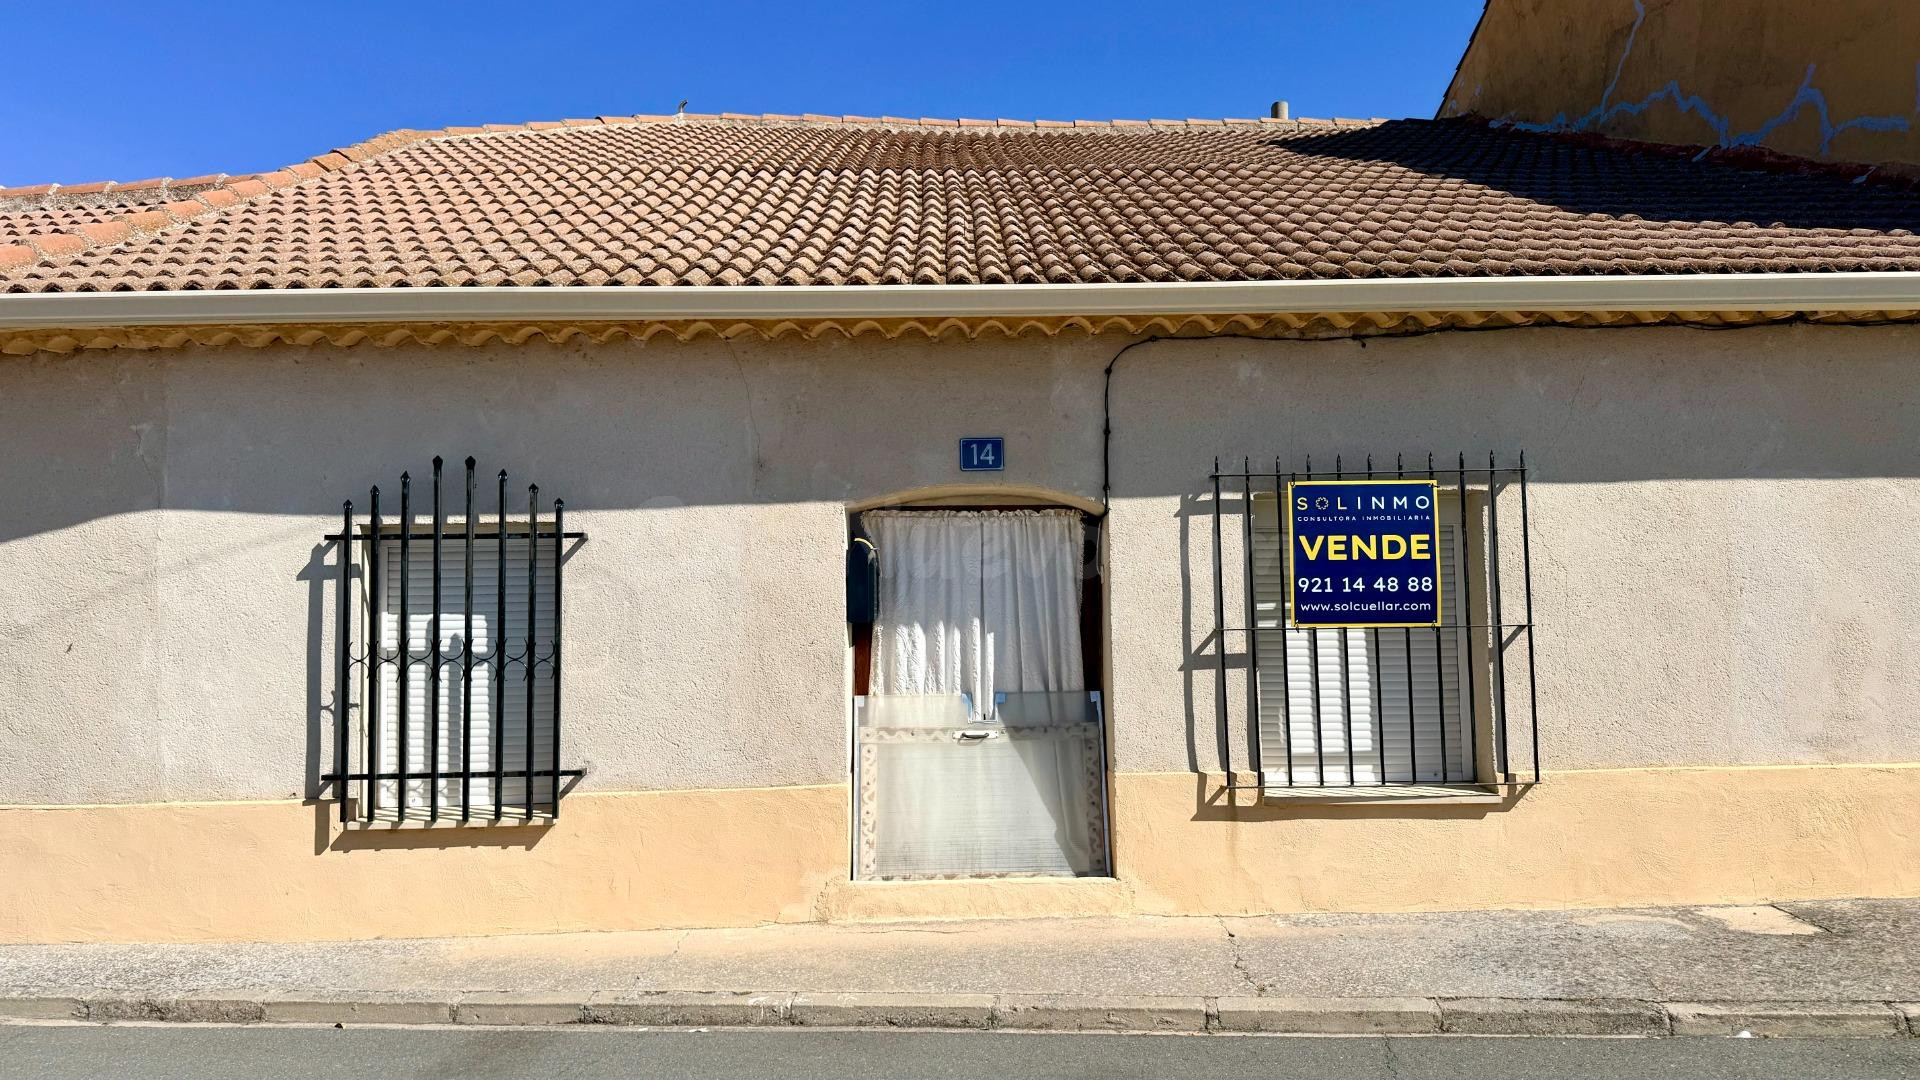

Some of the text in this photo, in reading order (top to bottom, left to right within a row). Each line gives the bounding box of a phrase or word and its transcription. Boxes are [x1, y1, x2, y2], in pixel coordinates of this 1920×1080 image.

[971, 443, 995, 465] 14
[1297, 496, 1430, 511] SOLINMO
[1299, 534, 1431, 561] VENDE
[1298, 577, 1433, 593] 921 14 48 88
[1301, 602, 1431, 611] www.solcuellar.com
